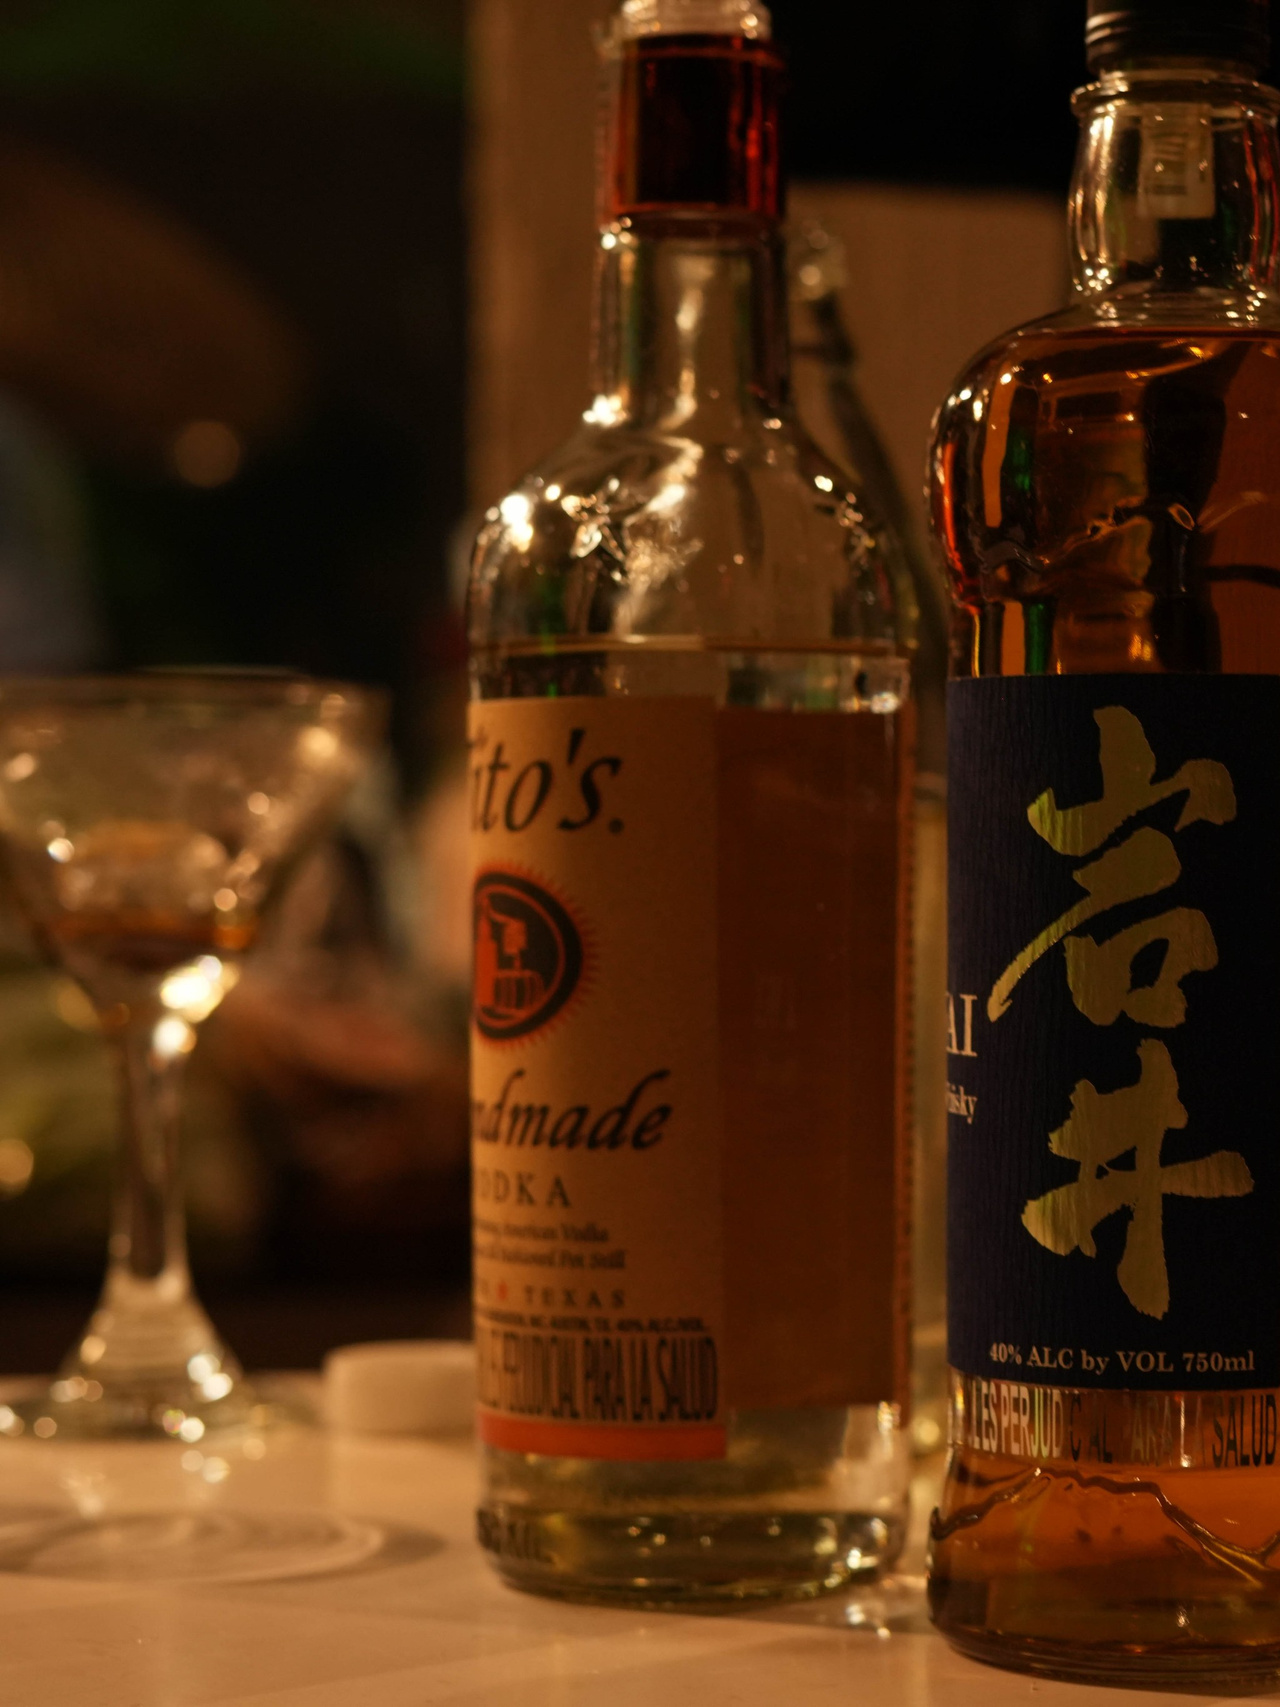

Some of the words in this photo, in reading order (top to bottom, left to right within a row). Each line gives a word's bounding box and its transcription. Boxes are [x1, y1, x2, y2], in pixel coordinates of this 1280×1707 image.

[987, 704, 1255, 1322] 岩井
[524, 1285, 626, 1308] TEXAS
[989, 1341, 1023, 1366] 40%
[1026, 1346, 1074, 1370] ALC
[1081, 1349, 1110, 1375] by
[1115, 1351, 1175, 1374] VOL
[1181, 1349, 1256, 1373] 750ml
[1001, 1382, 1113, 1464] PERJUDCAL
[1212, 1393, 1278, 1468] SALUD
